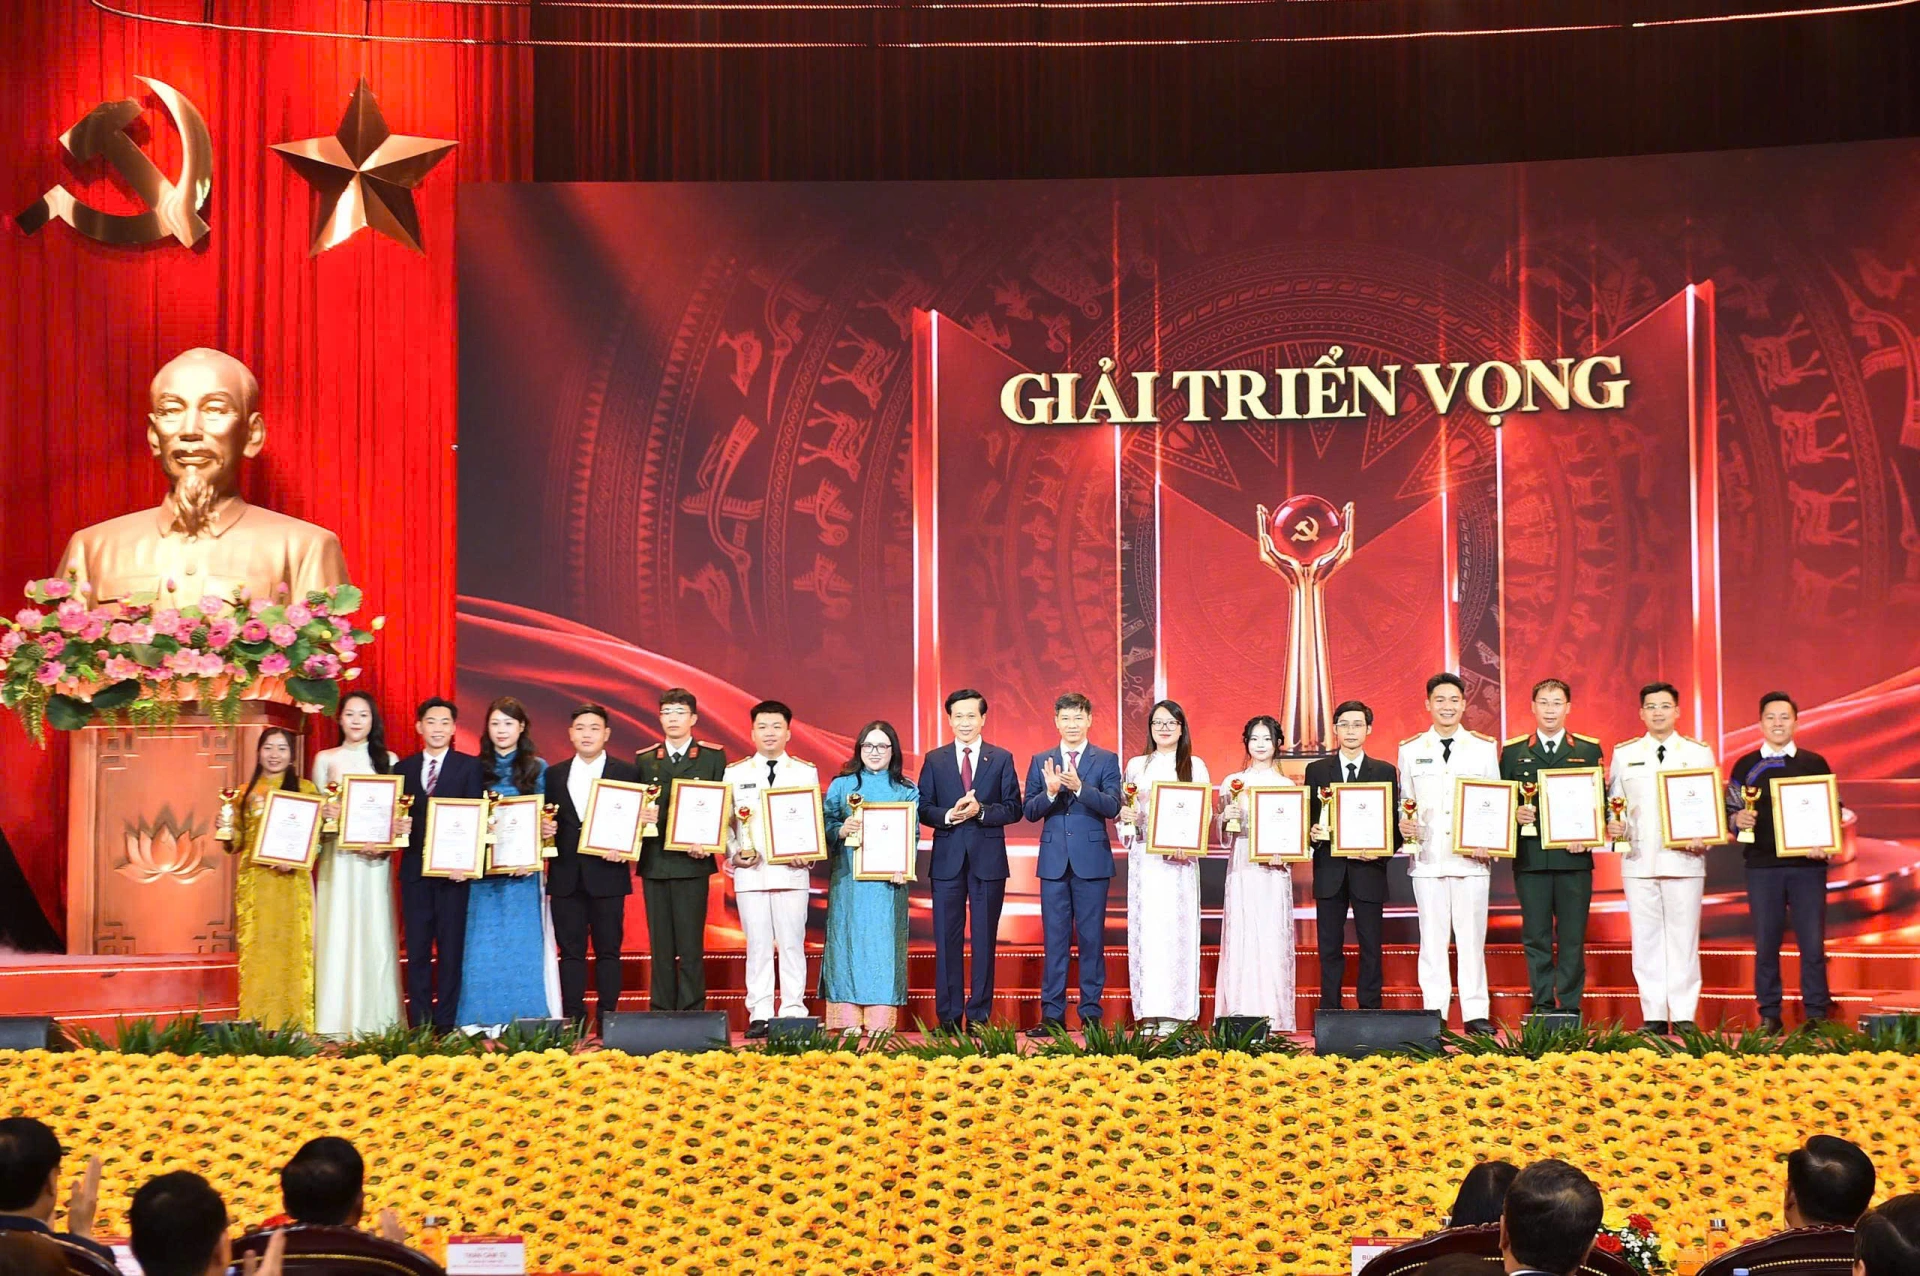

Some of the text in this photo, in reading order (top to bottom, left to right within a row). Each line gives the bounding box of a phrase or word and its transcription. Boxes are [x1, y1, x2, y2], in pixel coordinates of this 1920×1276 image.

[1000, 345, 1631, 427] GIẢI TRIỂN VỌNG
